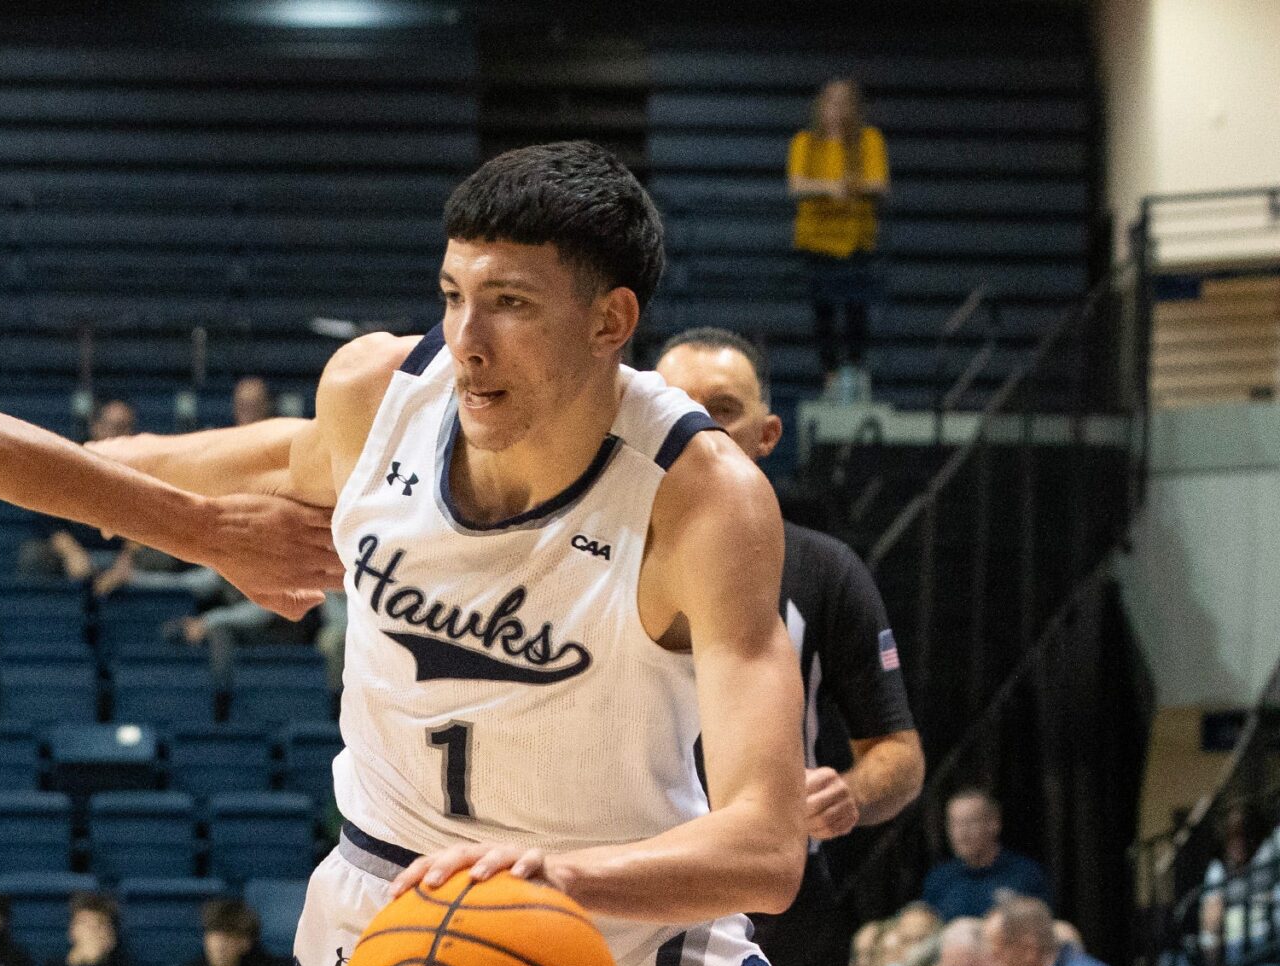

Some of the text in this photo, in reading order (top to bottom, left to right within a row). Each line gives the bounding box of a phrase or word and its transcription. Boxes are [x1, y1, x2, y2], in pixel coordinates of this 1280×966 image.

[571, 534, 612, 561] CAA
[354, 533, 562, 667] Hawks
[425, 719, 476, 820] 1
